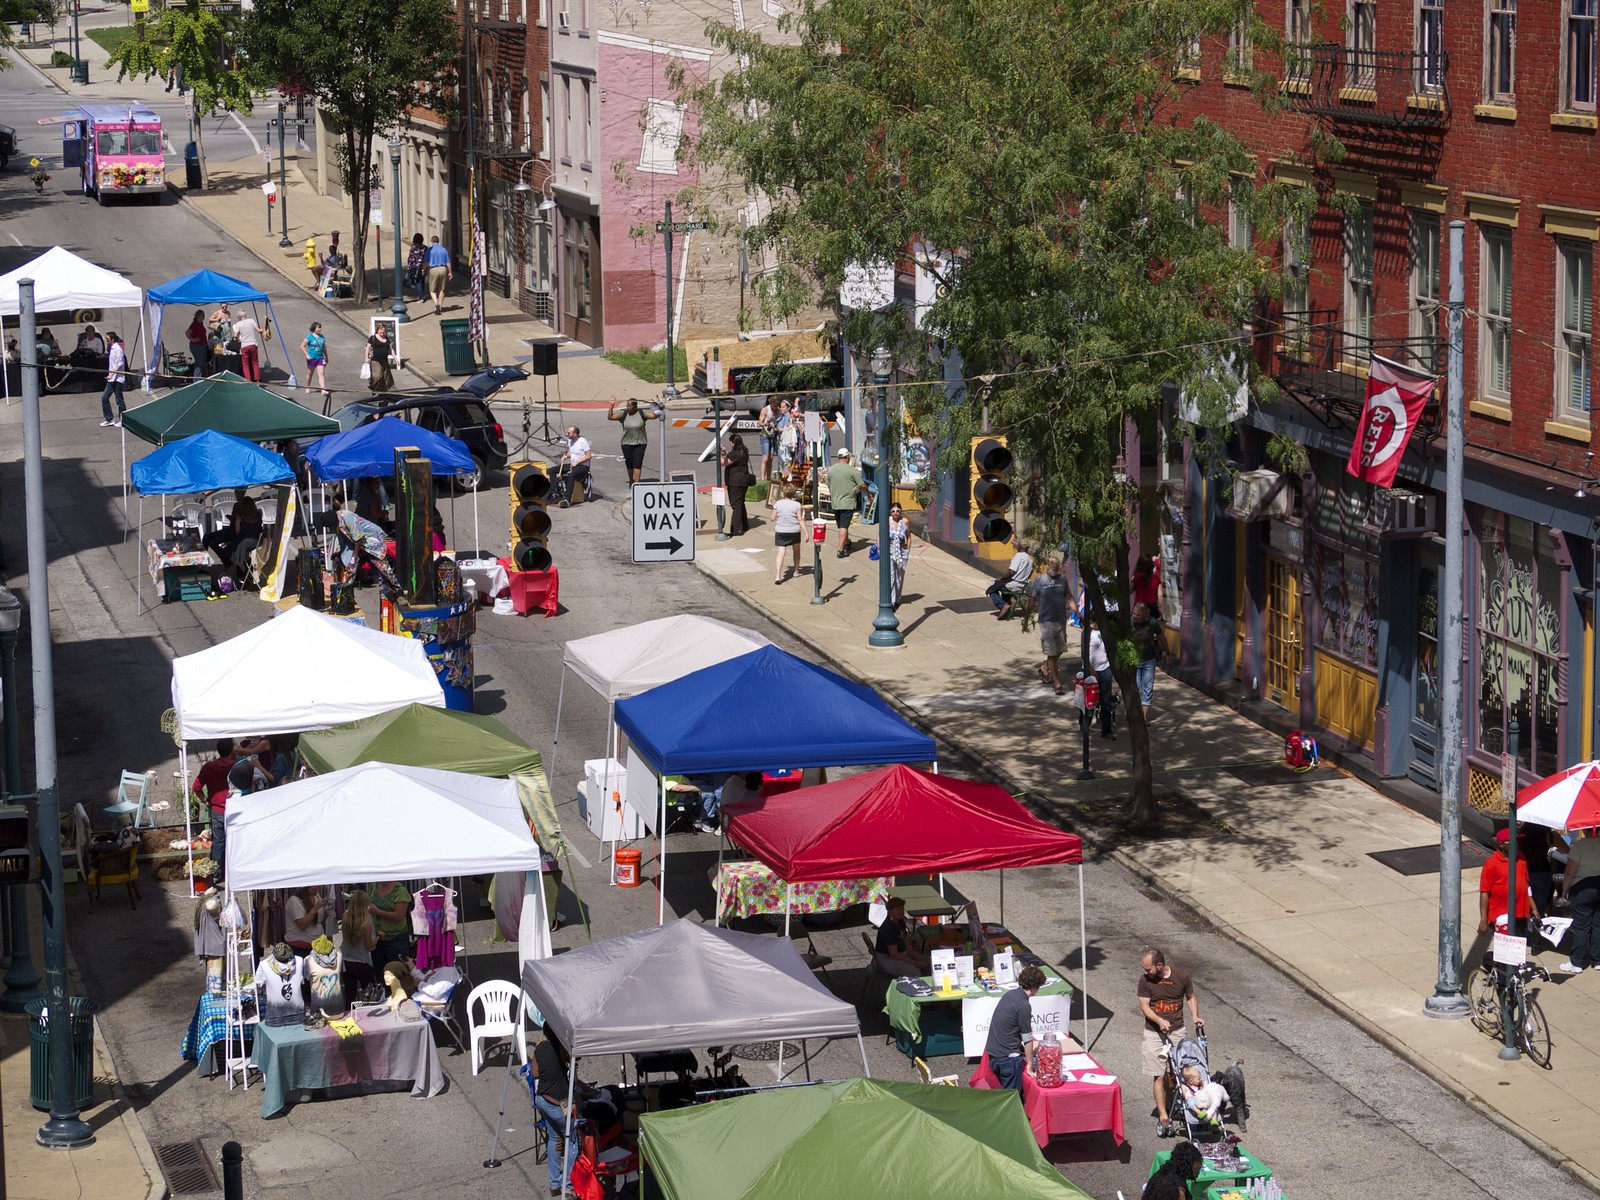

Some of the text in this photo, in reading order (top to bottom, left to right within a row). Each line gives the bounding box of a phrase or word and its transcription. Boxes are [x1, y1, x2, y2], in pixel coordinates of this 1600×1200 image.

[1361, 407, 1391, 467] REDS
[643, 491, 685, 509] ONE
[643, 512, 685, 530] WAY
[1507, 655, 1526, 680] MAIN
[1502, 937, 1526, 945] PARKING
